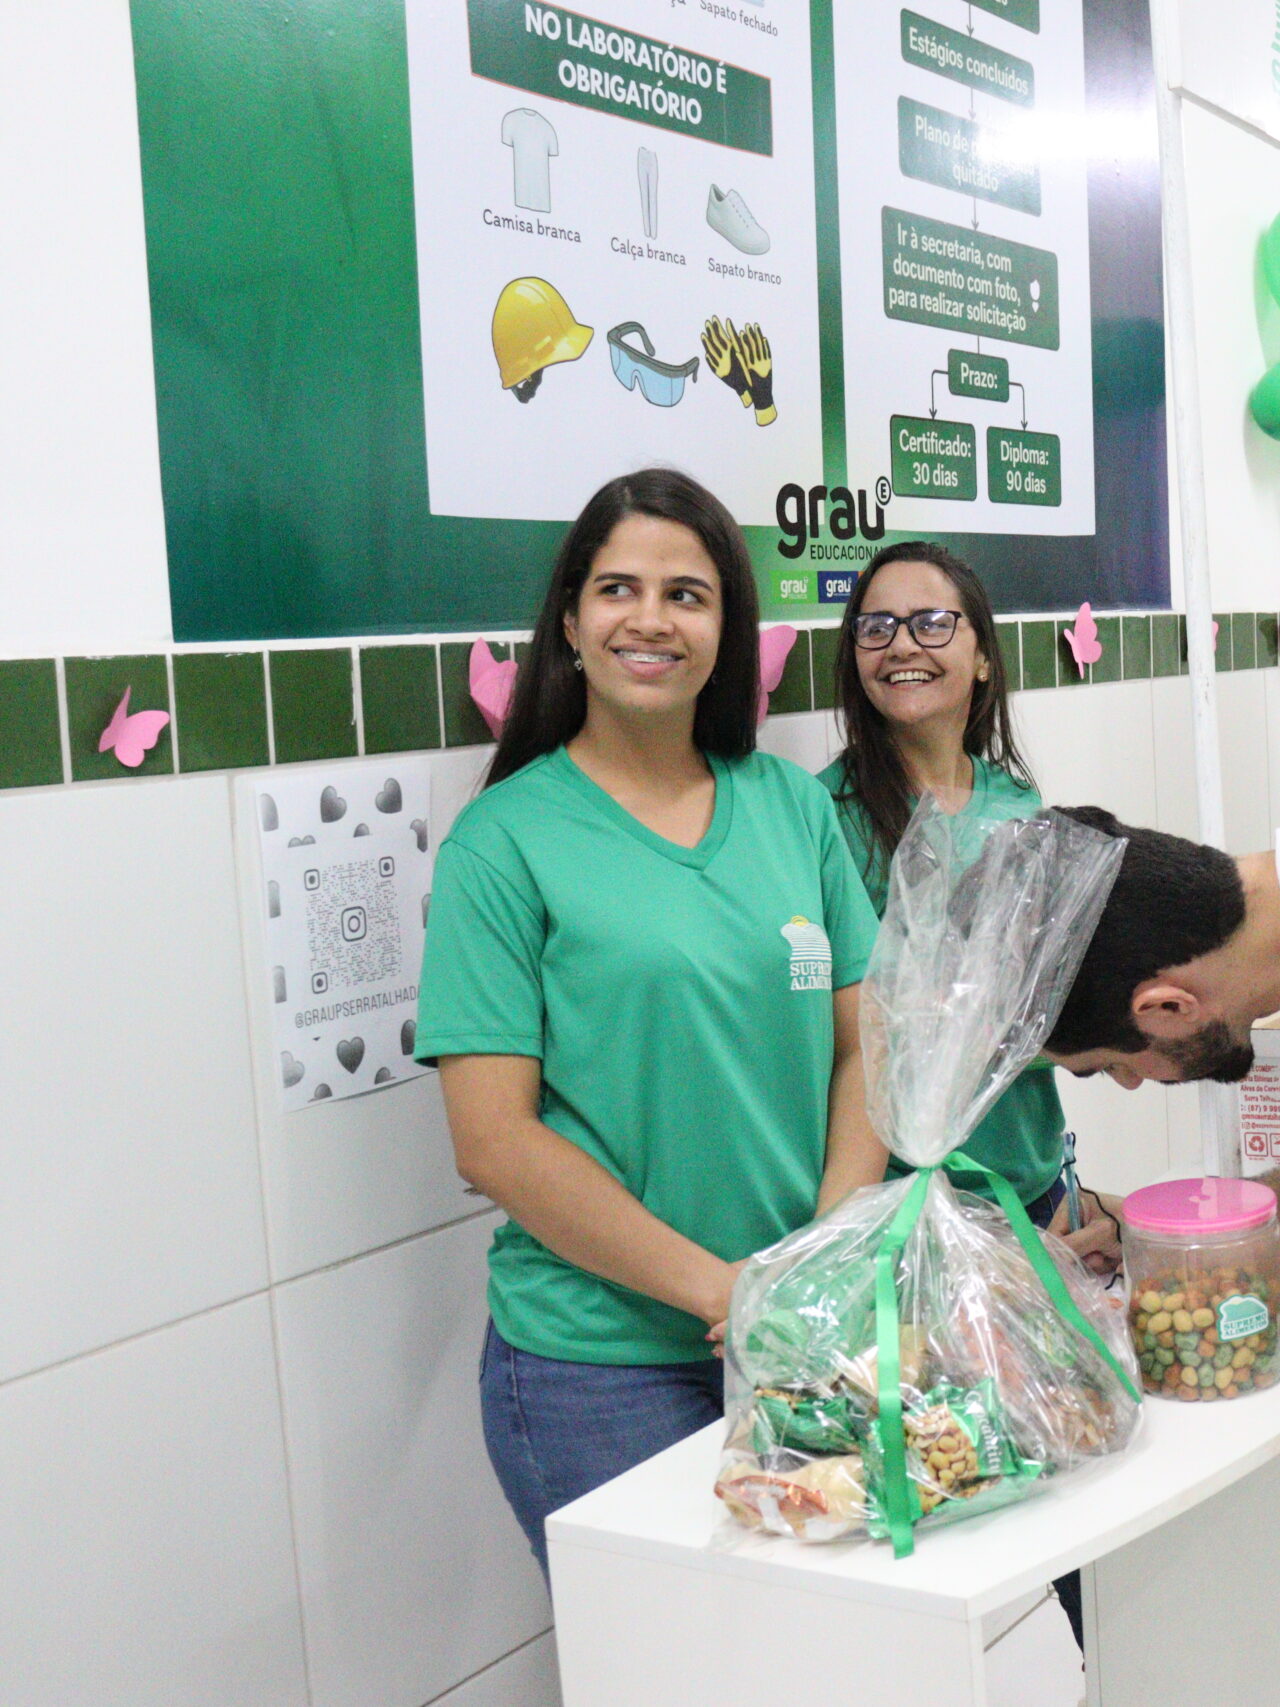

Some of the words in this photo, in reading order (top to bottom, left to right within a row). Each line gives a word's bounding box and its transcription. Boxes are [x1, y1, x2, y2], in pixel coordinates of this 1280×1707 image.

[739, 9, 779, 37] fechado
[525, 4, 562, 41] NO
[566, 17, 712, 88] LABORATÓRIO
[716, 61, 728, 94] É
[909, 26, 964, 69] Estágios
[966, 56, 1028, 95] concluídos
[558, 59, 702, 125] OBRIGATÓRIO
[914, 115, 950, 146] Plano
[953, 129, 968, 152] de
[953, 161, 999, 192] quitado
[482, 209, 534, 235] Camisa
[536, 216, 582, 243] branca
[610, 236, 645, 260] Calça
[646, 244, 687, 266] branca
[897, 223, 907, 246] Ir
[911, 226, 918, 249] à
[921, 236, 985, 270] secretaria,
[987, 252, 1012, 273] com
[708, 258, 746, 279] Sapato
[747, 261, 782, 285] branco
[893, 253, 964, 290] documento
[967, 277, 992, 297] com
[995, 277, 1021, 306] foto,
[889, 287, 917, 309] para
[920, 291, 964, 318] realizar
[967, 303, 1026, 334] solicitação
[961, 362, 998, 389] Prazo:
[899, 429, 971, 458] Certificado:
[1000, 440, 1049, 468] Diploma:
[913, 462, 930, 485] 30
[933, 463, 958, 487] dias
[1006, 471, 1021, 491] 90
[1024, 472, 1046, 494] dias
[776, 483, 885, 559] grau
[826, 580, 851, 597] grau
[1224, 1312, 1267, 1330] SUPREMO
